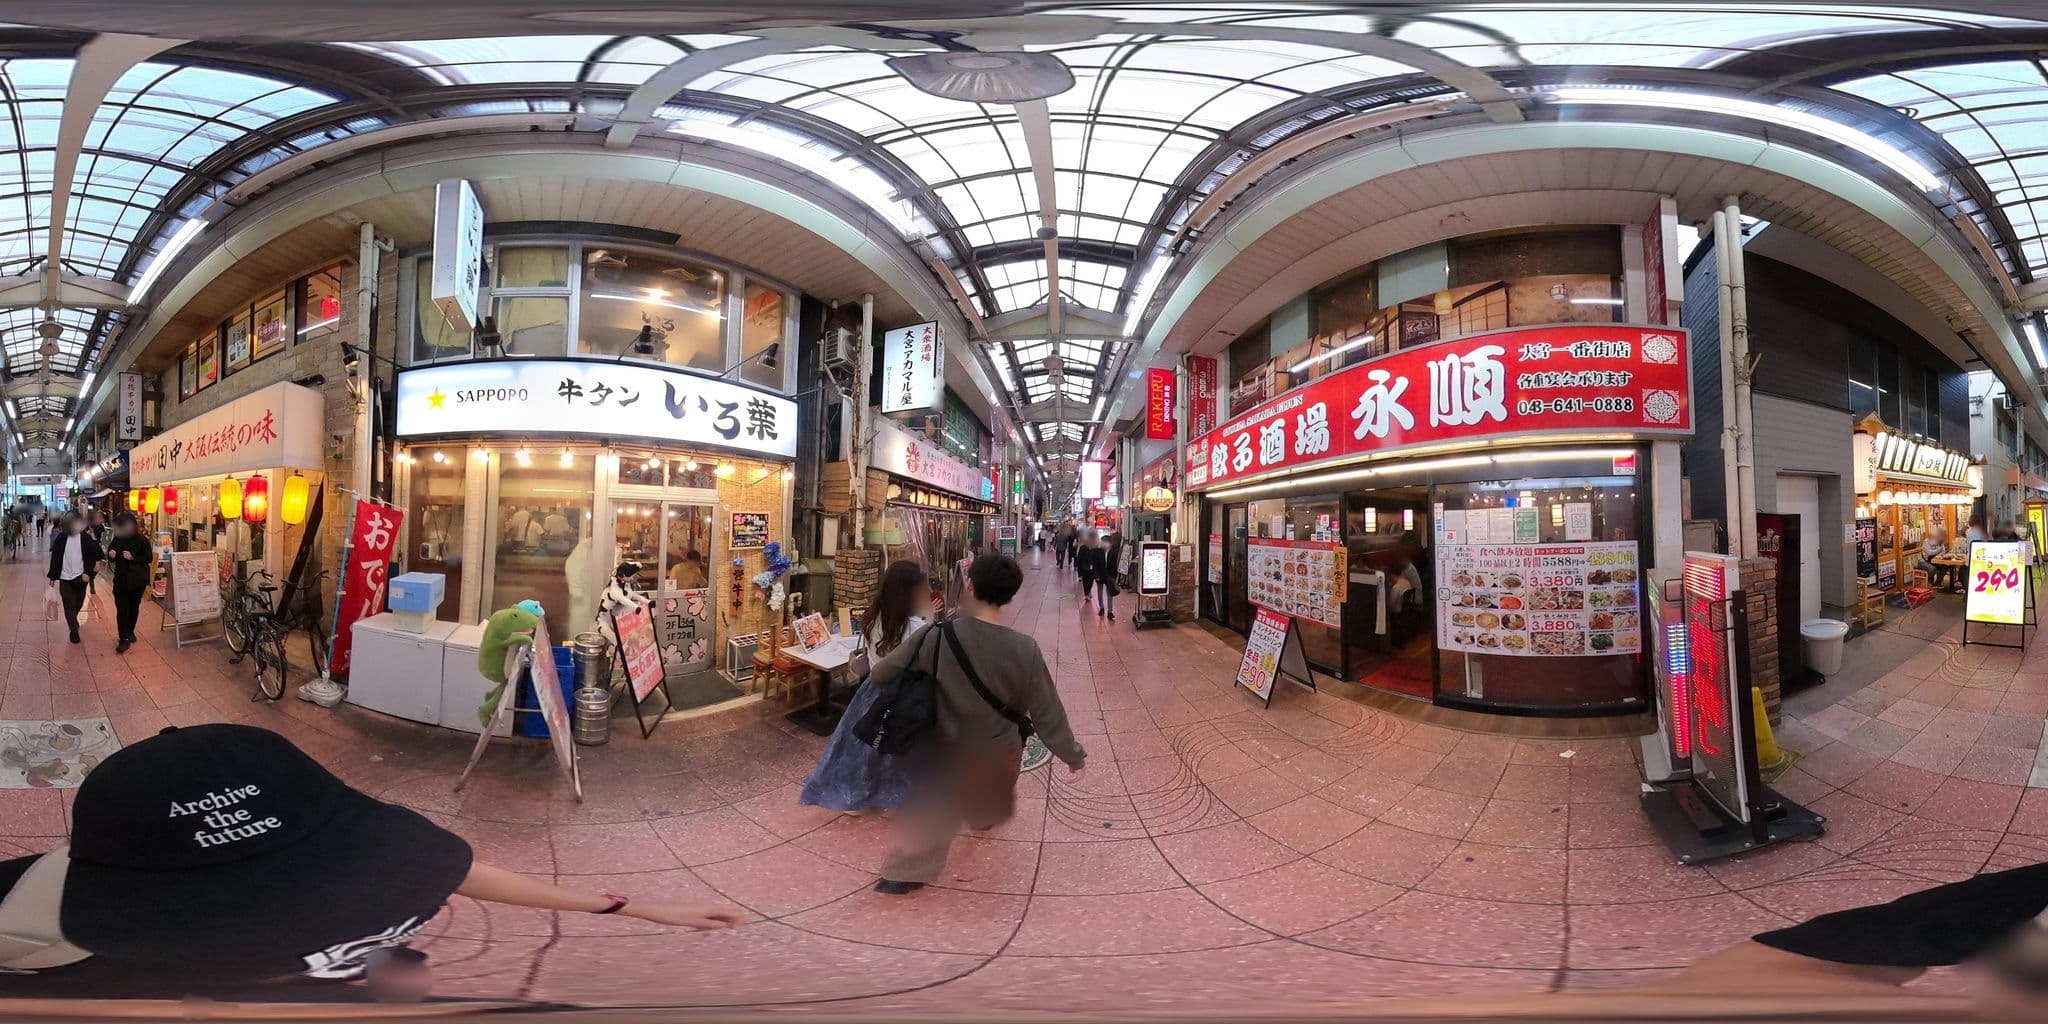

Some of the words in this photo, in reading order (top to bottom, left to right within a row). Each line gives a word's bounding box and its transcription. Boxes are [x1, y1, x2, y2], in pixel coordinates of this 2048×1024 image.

[920, 326, 932, 362] 大衆酒場
[1518, 341, 1631, 361] 大宮一番街店
[901, 330, 916, 406] 大宮アカマル屋
[558, 378, 640, 407] 牛タン
[664, 379, 779, 441] いろ葉
[1151, 373, 1164, 432] RAKERU
[125, 415, 137, 438] 田中
[157, 439, 182, 471] 田中
[184, 409, 278, 463] 大阪伝統の味
[1480, 547, 1533, 556] 食べ飲み放題
[1974, 567, 2019, 592] 290
[665, 621, 676, 630] 2F
[667, 632, 676, 641] 1F
[1246, 648, 1260, 664] 全品
[1241, 663, 1266, 689] 290
[169, 784, 261, 818] Archive
[203, 809, 252, 829] the
[193, 816, 282, 848] future
